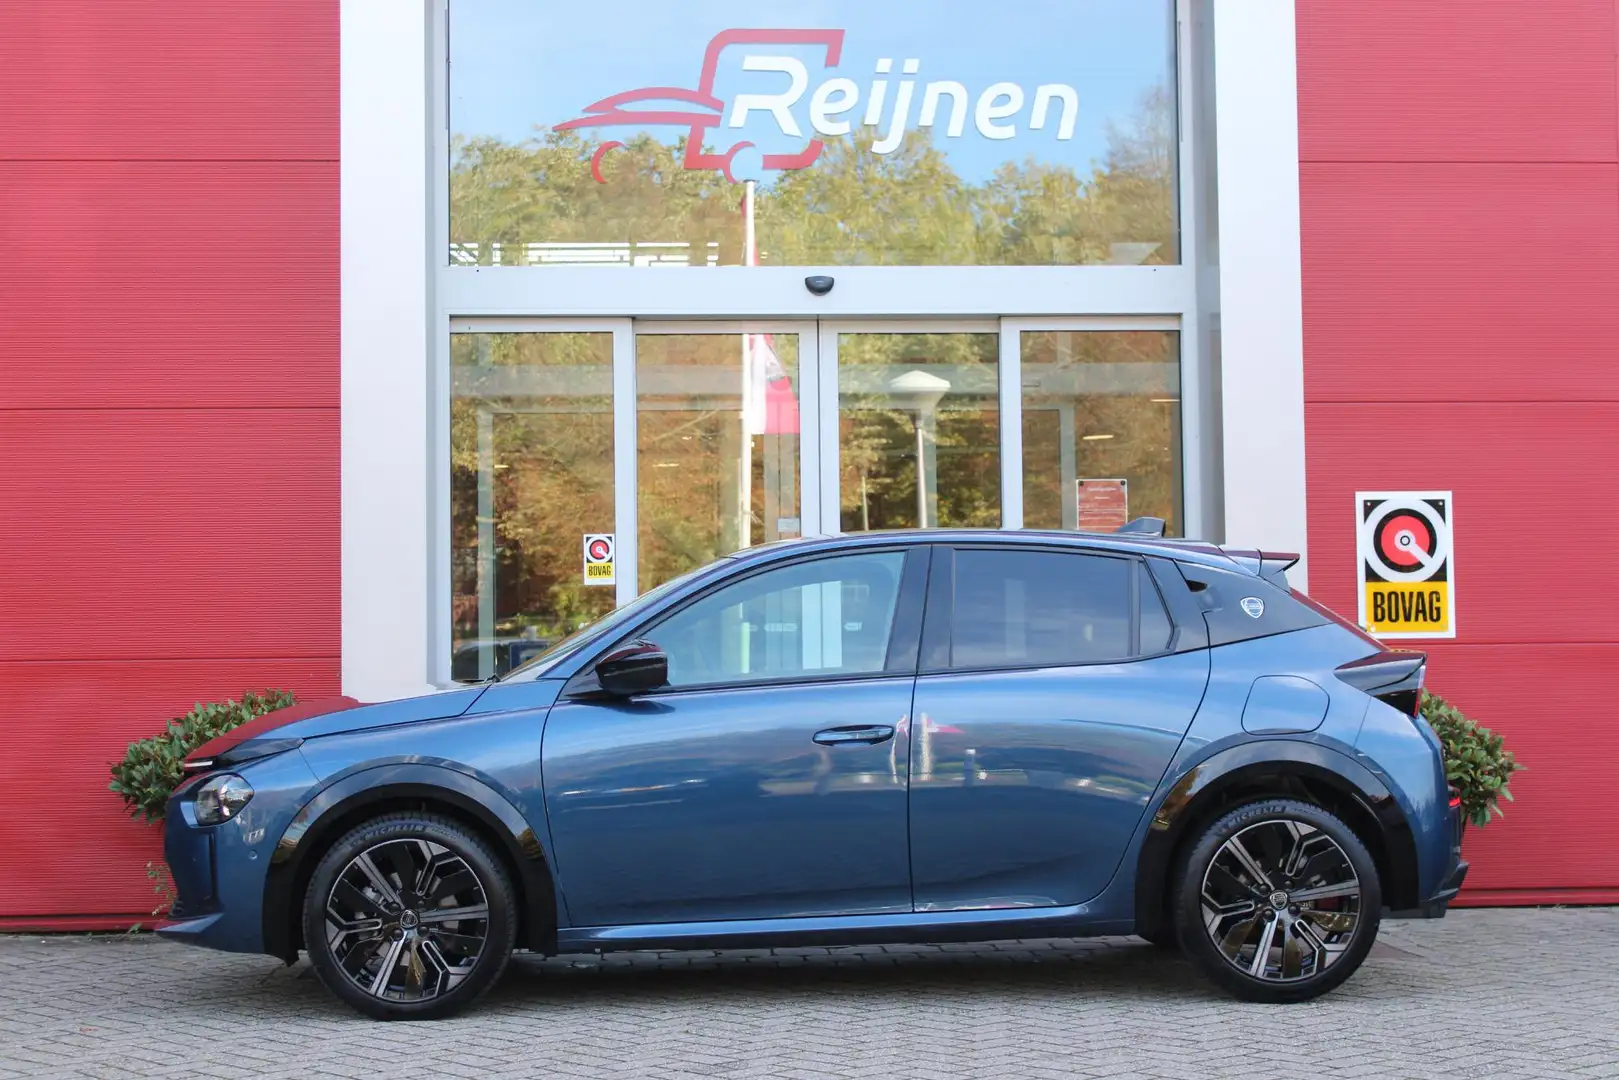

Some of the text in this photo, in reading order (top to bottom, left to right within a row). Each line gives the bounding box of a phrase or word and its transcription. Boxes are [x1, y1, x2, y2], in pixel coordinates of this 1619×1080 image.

[728, 55, 1079, 155] Reijnen
[588, 565, 611, 576] BOVAG
[1372, 590, 1441, 623] BOVAG
[1227, 806, 1283, 827] MICHELIN
[365, 824, 423, 840] MICHELIN
